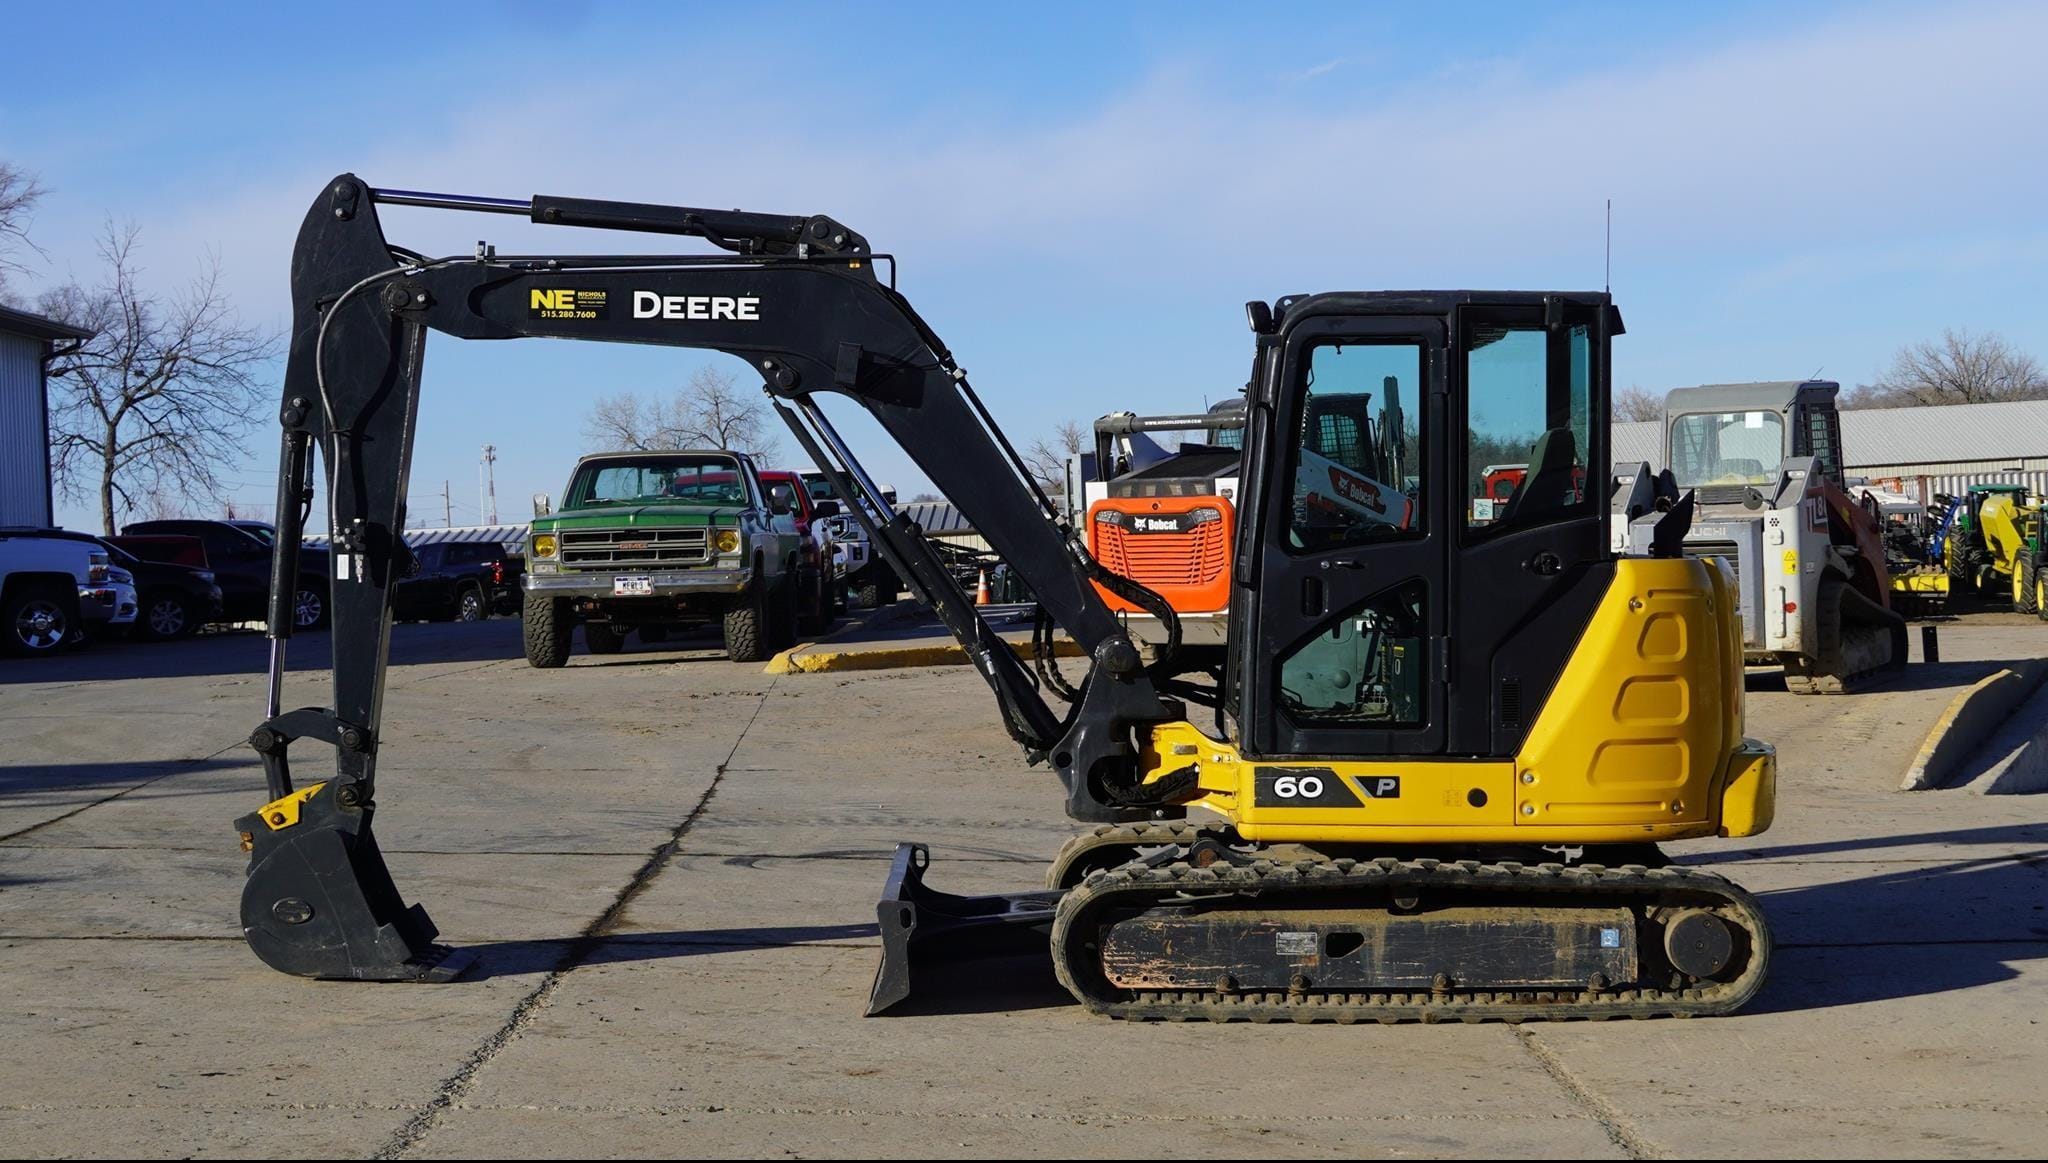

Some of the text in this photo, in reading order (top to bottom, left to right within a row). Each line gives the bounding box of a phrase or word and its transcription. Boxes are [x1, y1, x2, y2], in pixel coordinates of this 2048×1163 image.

[531, 289, 575, 310] NE
[633, 291, 760, 320] DEERE
[541, 310, 597, 318] 515.280.7600
[1349, 483, 1375, 506] Bobcat
[1148, 519, 1179, 530] Bobcat
[1274, 776, 1396, 798] 60 P
